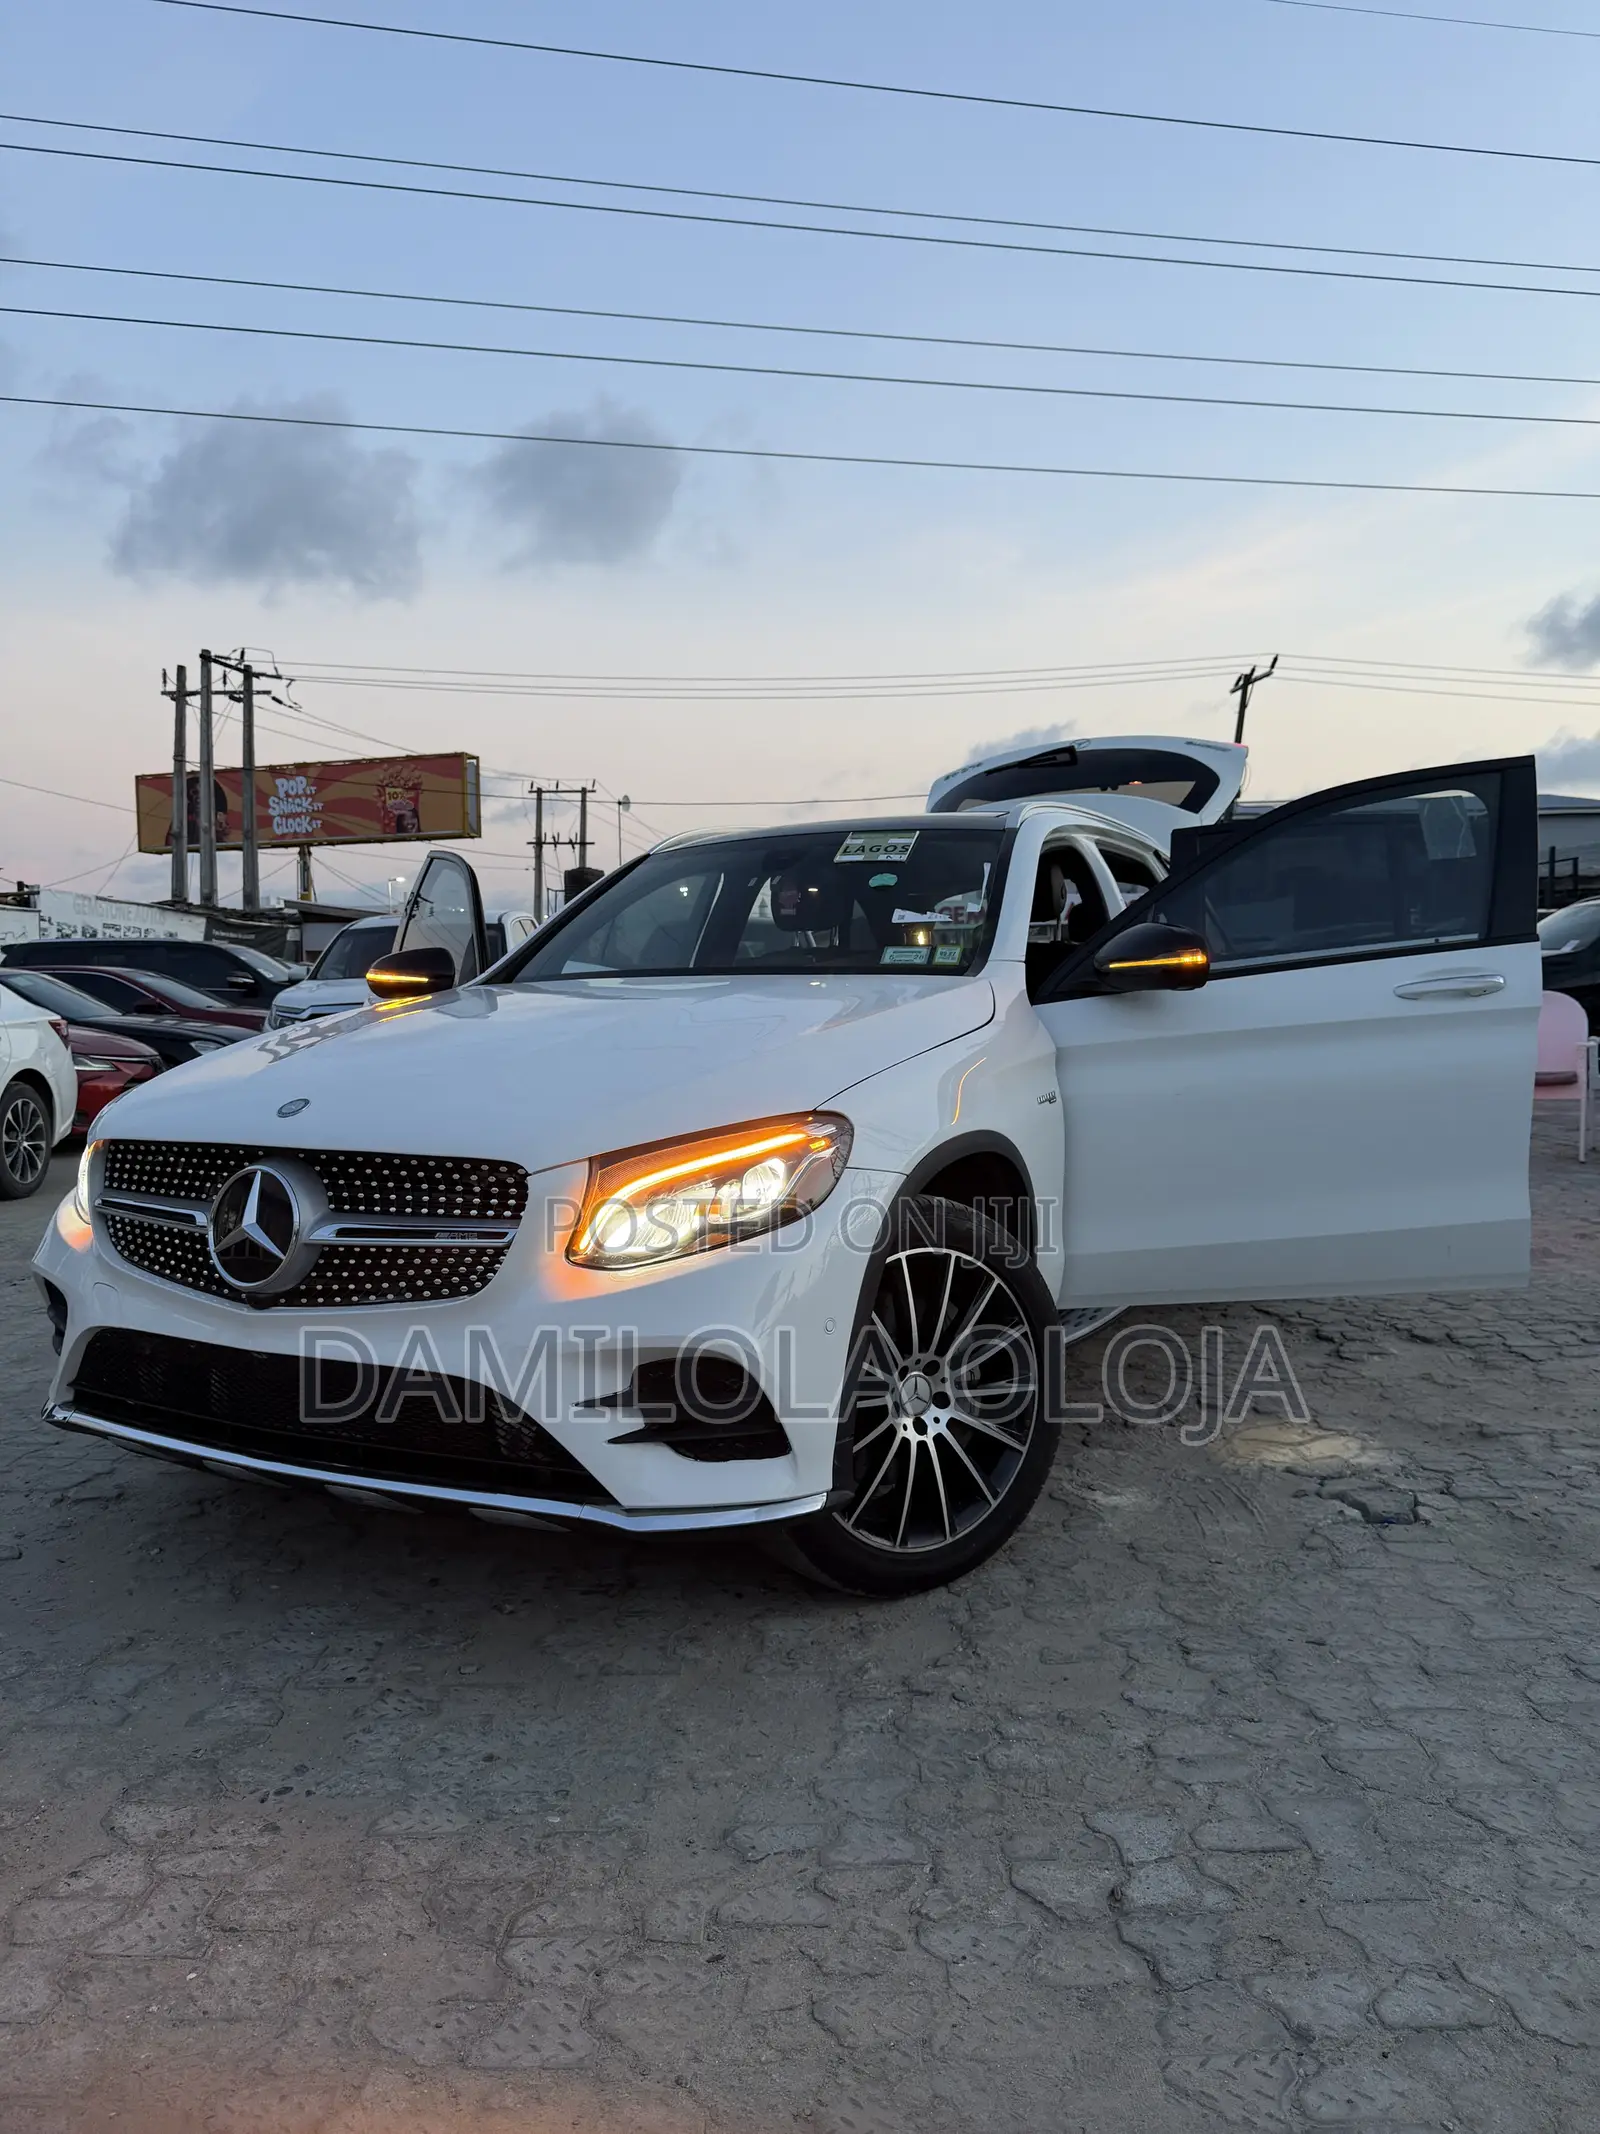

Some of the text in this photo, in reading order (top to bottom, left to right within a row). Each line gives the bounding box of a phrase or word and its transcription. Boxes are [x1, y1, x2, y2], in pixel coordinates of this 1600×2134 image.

[275, 776, 307, 798] POP
[268, 796, 313, 816] SNACK
[843, 844, 911, 854] LAGOS
